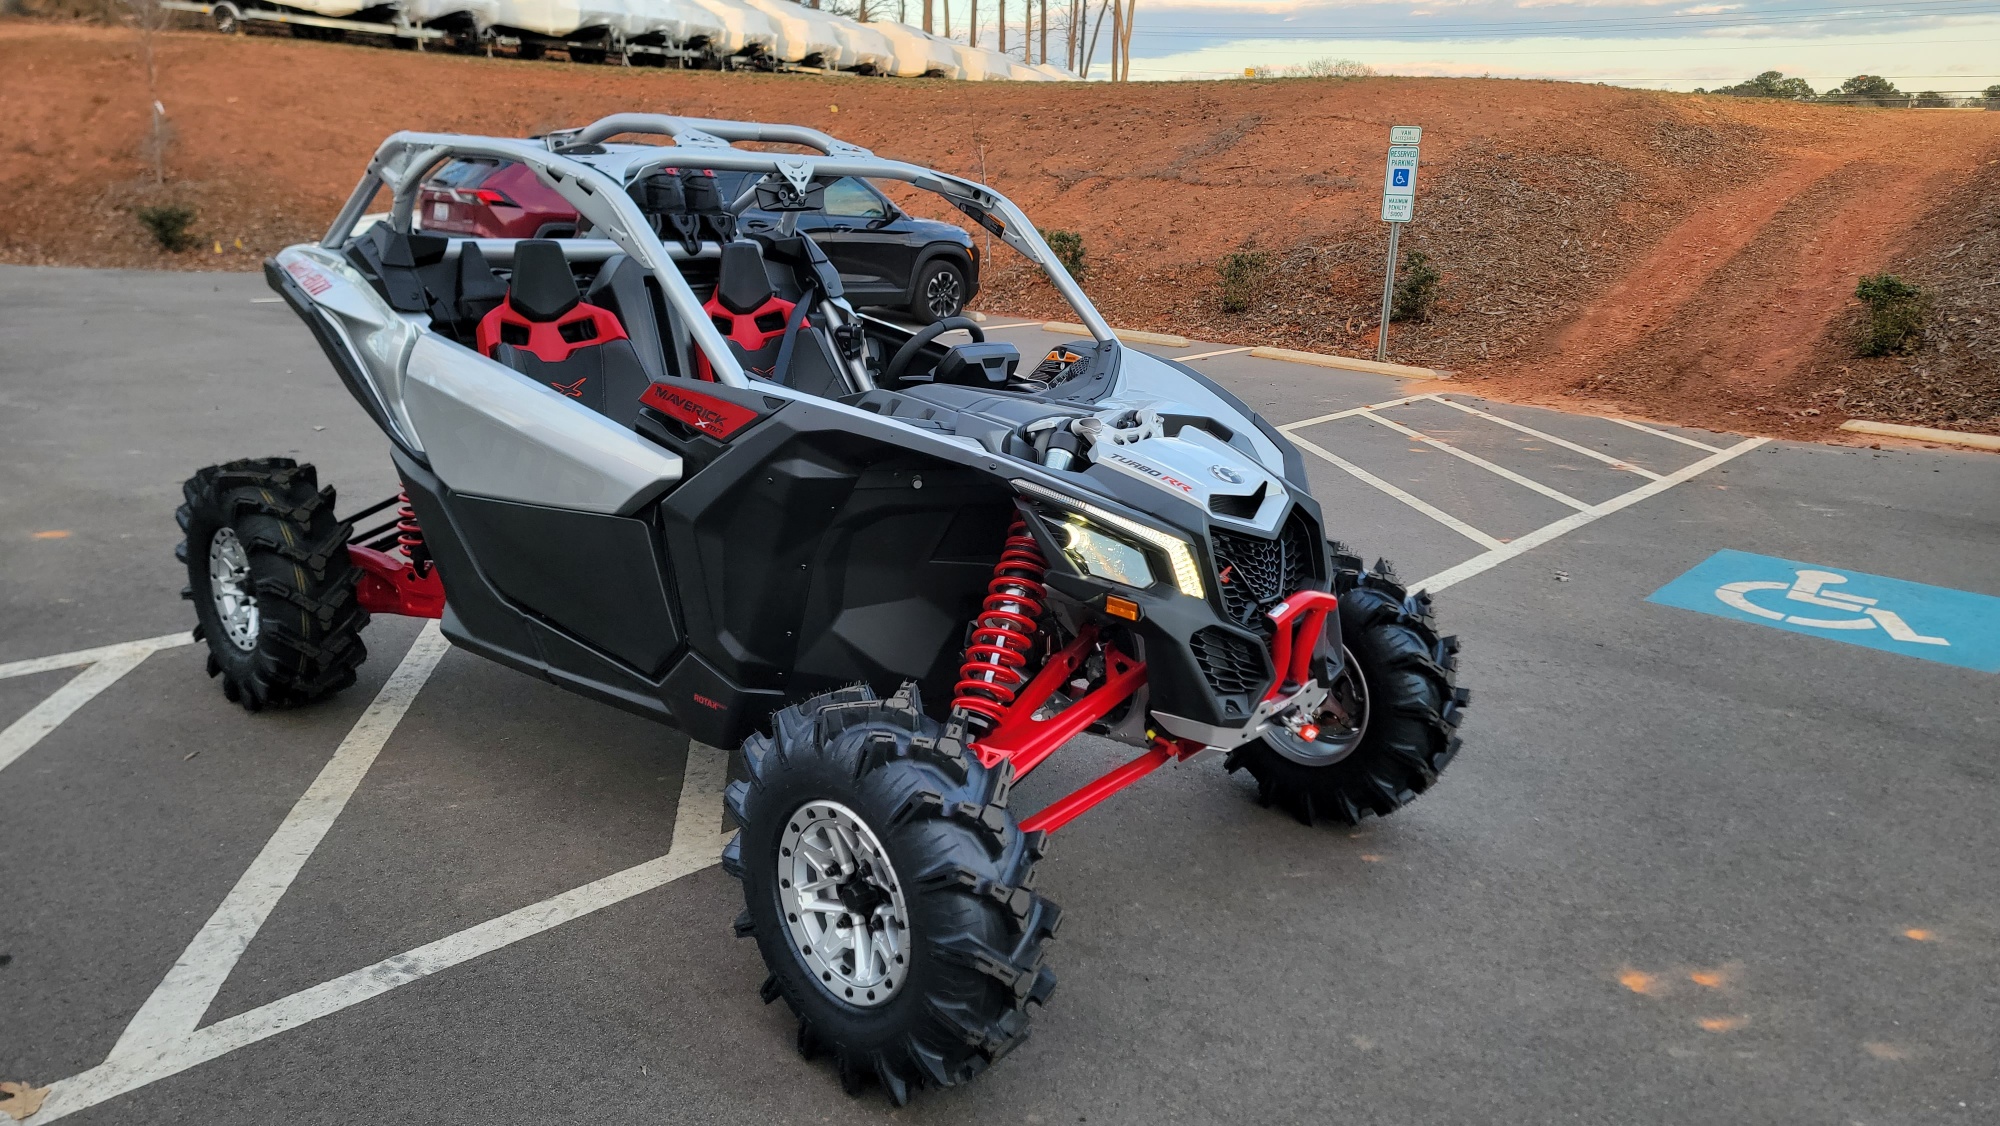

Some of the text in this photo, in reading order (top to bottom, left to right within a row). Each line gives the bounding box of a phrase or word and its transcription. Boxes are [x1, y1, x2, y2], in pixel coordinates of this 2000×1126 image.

[1390, 150, 1417, 158] RESERVED
[655, 386, 728, 427] MAVERICK
[1110, 453, 1193, 493] TURBO RR
[693, 693, 718, 710] ROTAX
